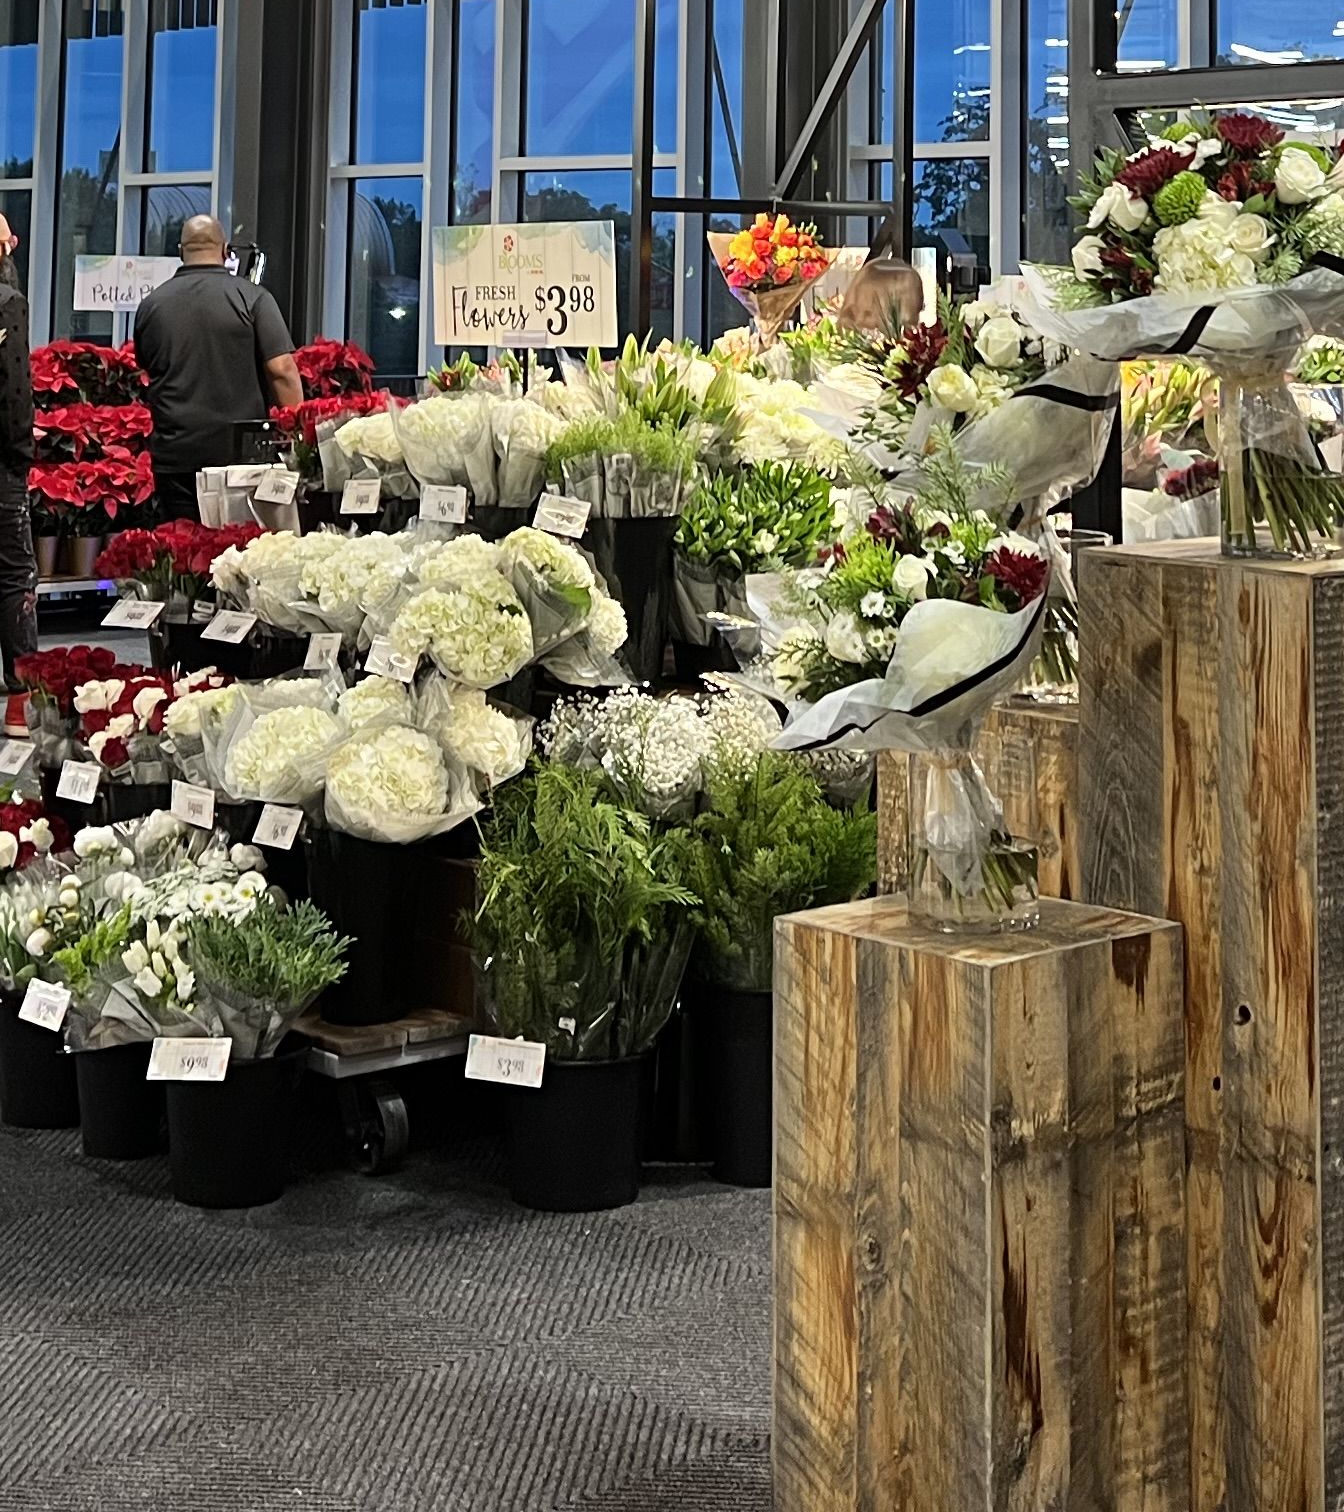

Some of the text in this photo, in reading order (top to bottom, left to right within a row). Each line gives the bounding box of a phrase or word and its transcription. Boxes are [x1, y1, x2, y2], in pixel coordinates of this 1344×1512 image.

[571, 273, 591, 283] FROM
[475, 285, 516, 301] FRESH
[452, 285, 530, 337] Flowers
